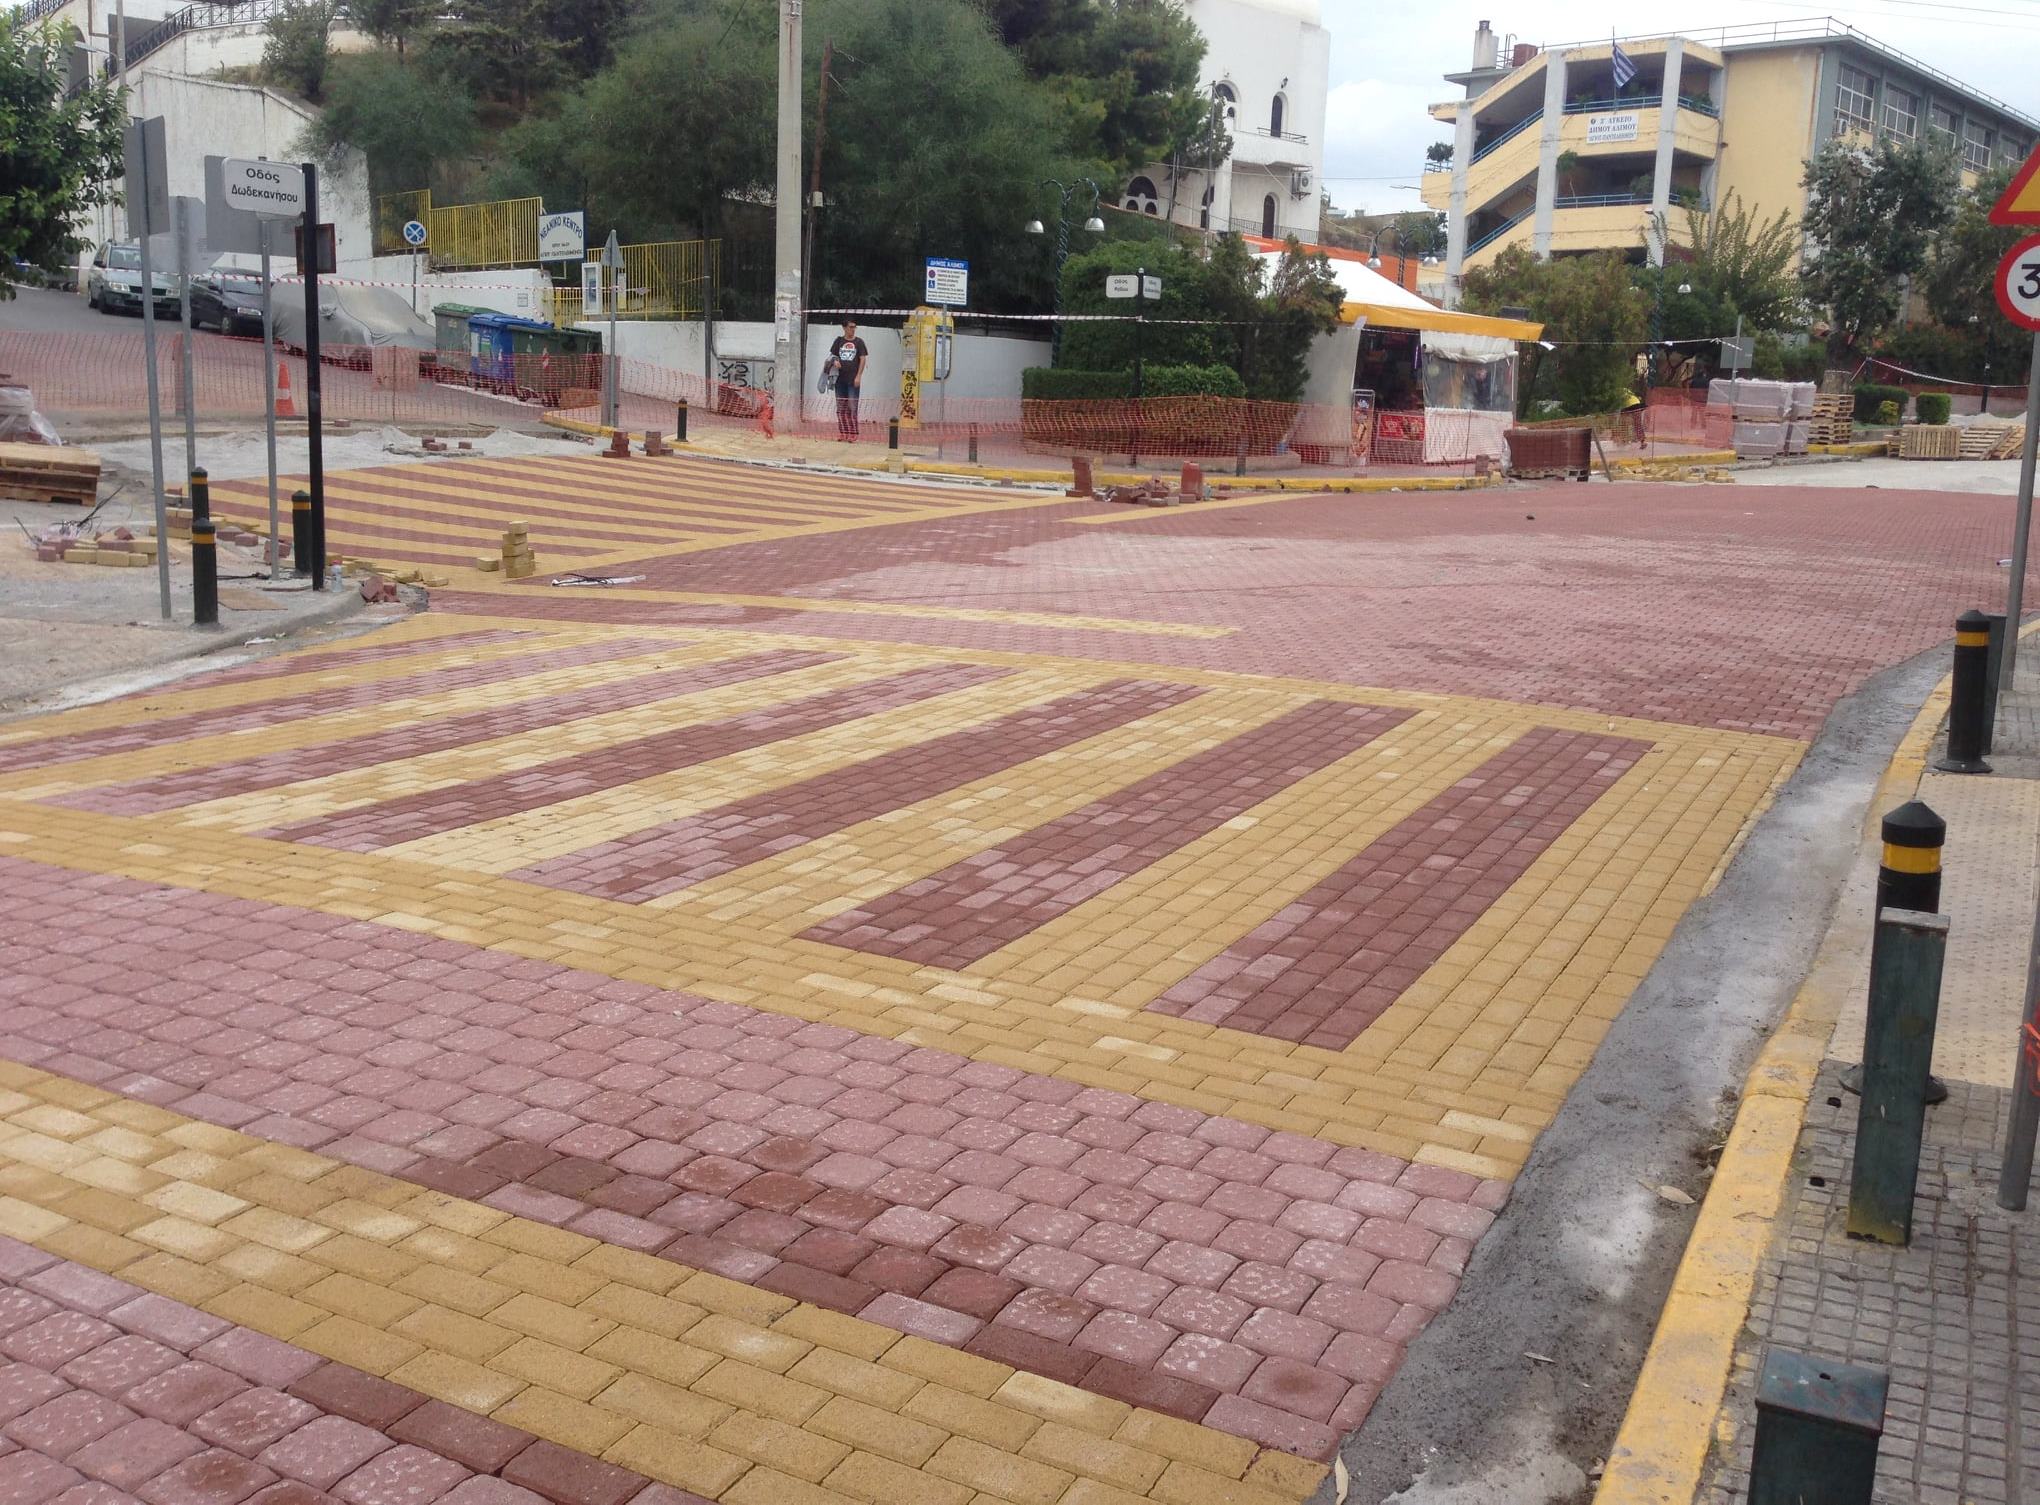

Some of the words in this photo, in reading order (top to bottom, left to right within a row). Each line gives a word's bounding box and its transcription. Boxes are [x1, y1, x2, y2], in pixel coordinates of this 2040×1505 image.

[246, 168, 280, 184] Οδός
[231, 184, 298, 203] Δωδεκανήσου
[563, 216, 583, 239] ΚΕΝΤΡΟ
